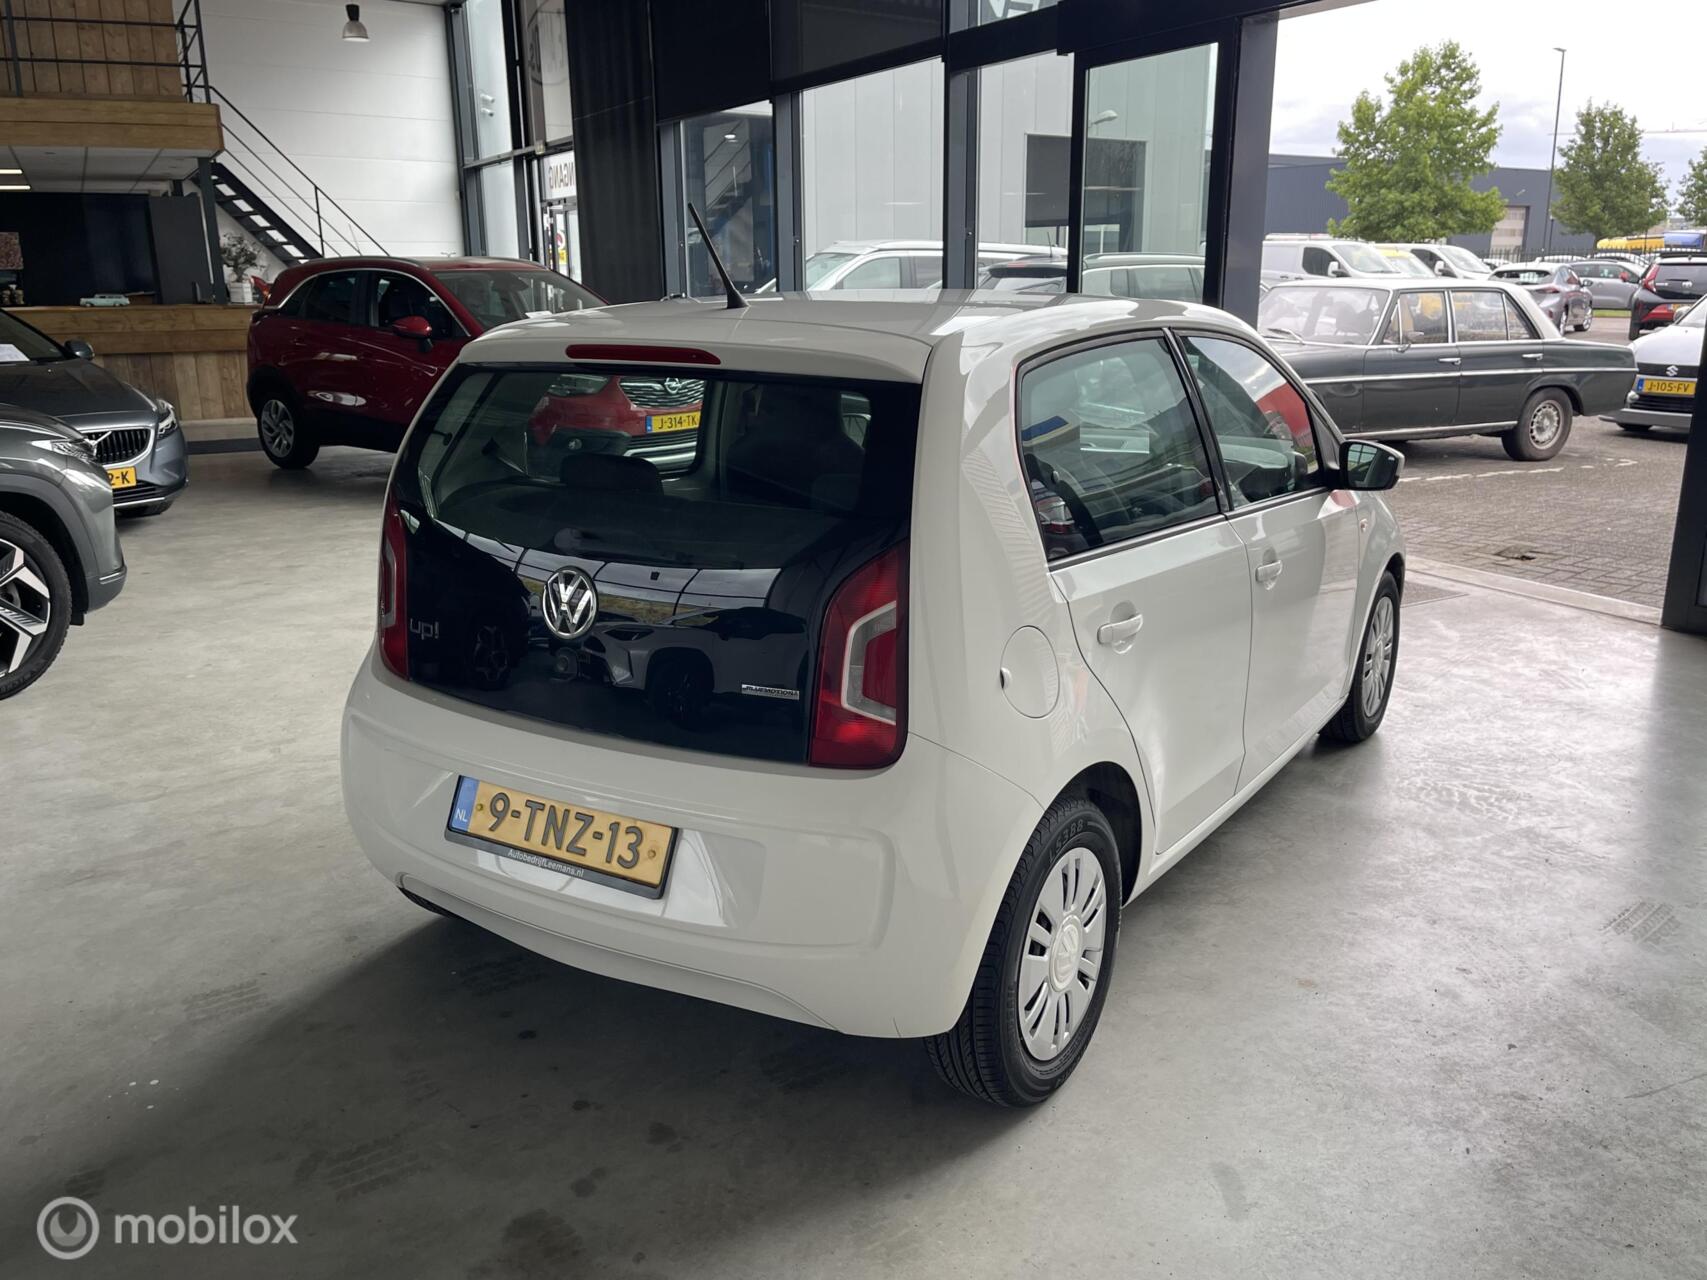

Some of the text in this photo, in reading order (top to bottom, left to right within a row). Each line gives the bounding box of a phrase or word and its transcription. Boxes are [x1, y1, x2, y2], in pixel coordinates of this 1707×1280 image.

[1647, 381, 1690, 393] J-105-FV
[658, 414, 698, 430] J-314-TK
[409, 617, 440, 640] up!
[455, 807, 468, 823] NL
[488, 791, 644, 870] 9-TNZ-13
[507, 847, 585, 878] AutobedrijfLeemans.nl
